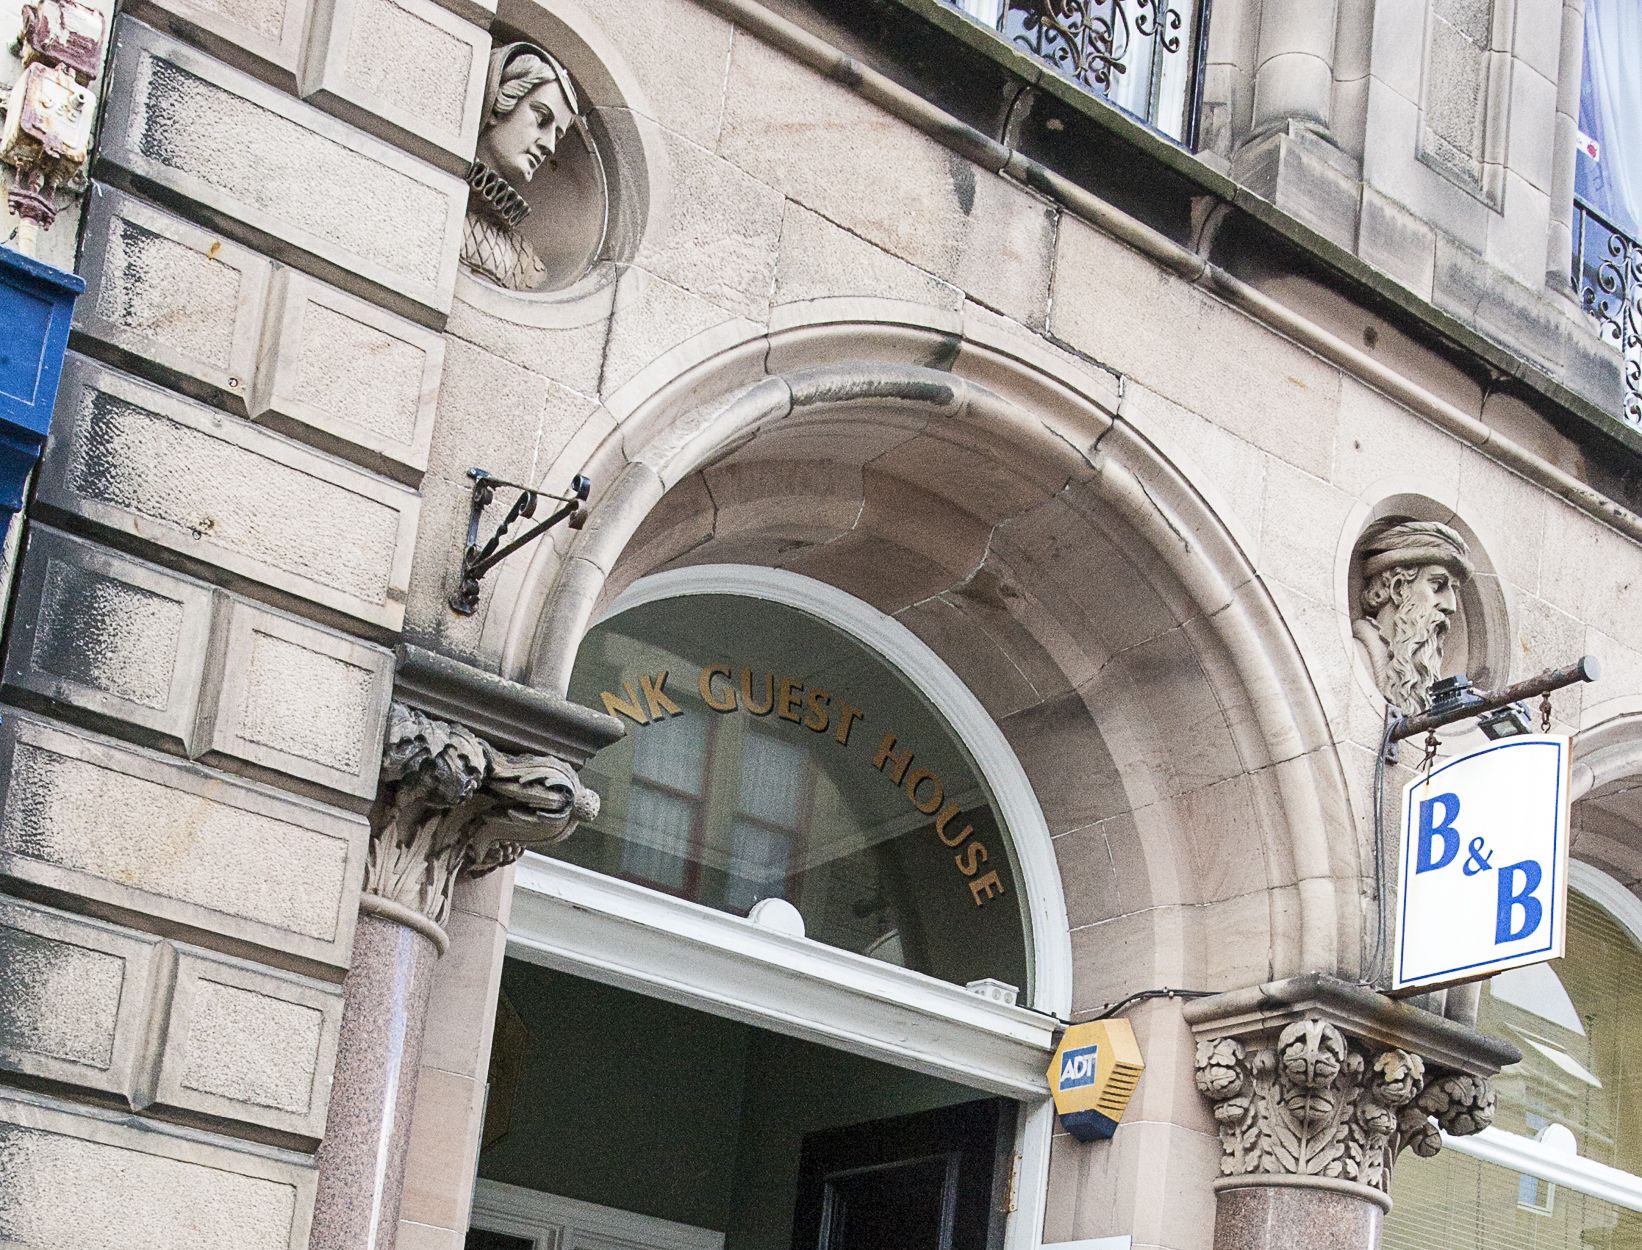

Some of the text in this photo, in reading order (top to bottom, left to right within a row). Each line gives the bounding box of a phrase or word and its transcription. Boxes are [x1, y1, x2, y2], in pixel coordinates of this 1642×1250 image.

[699, 664, 864, 746] GUEST
[872, 731, 1006, 907] HOUSE
[1060, 1052, 1098, 1082] ADT
